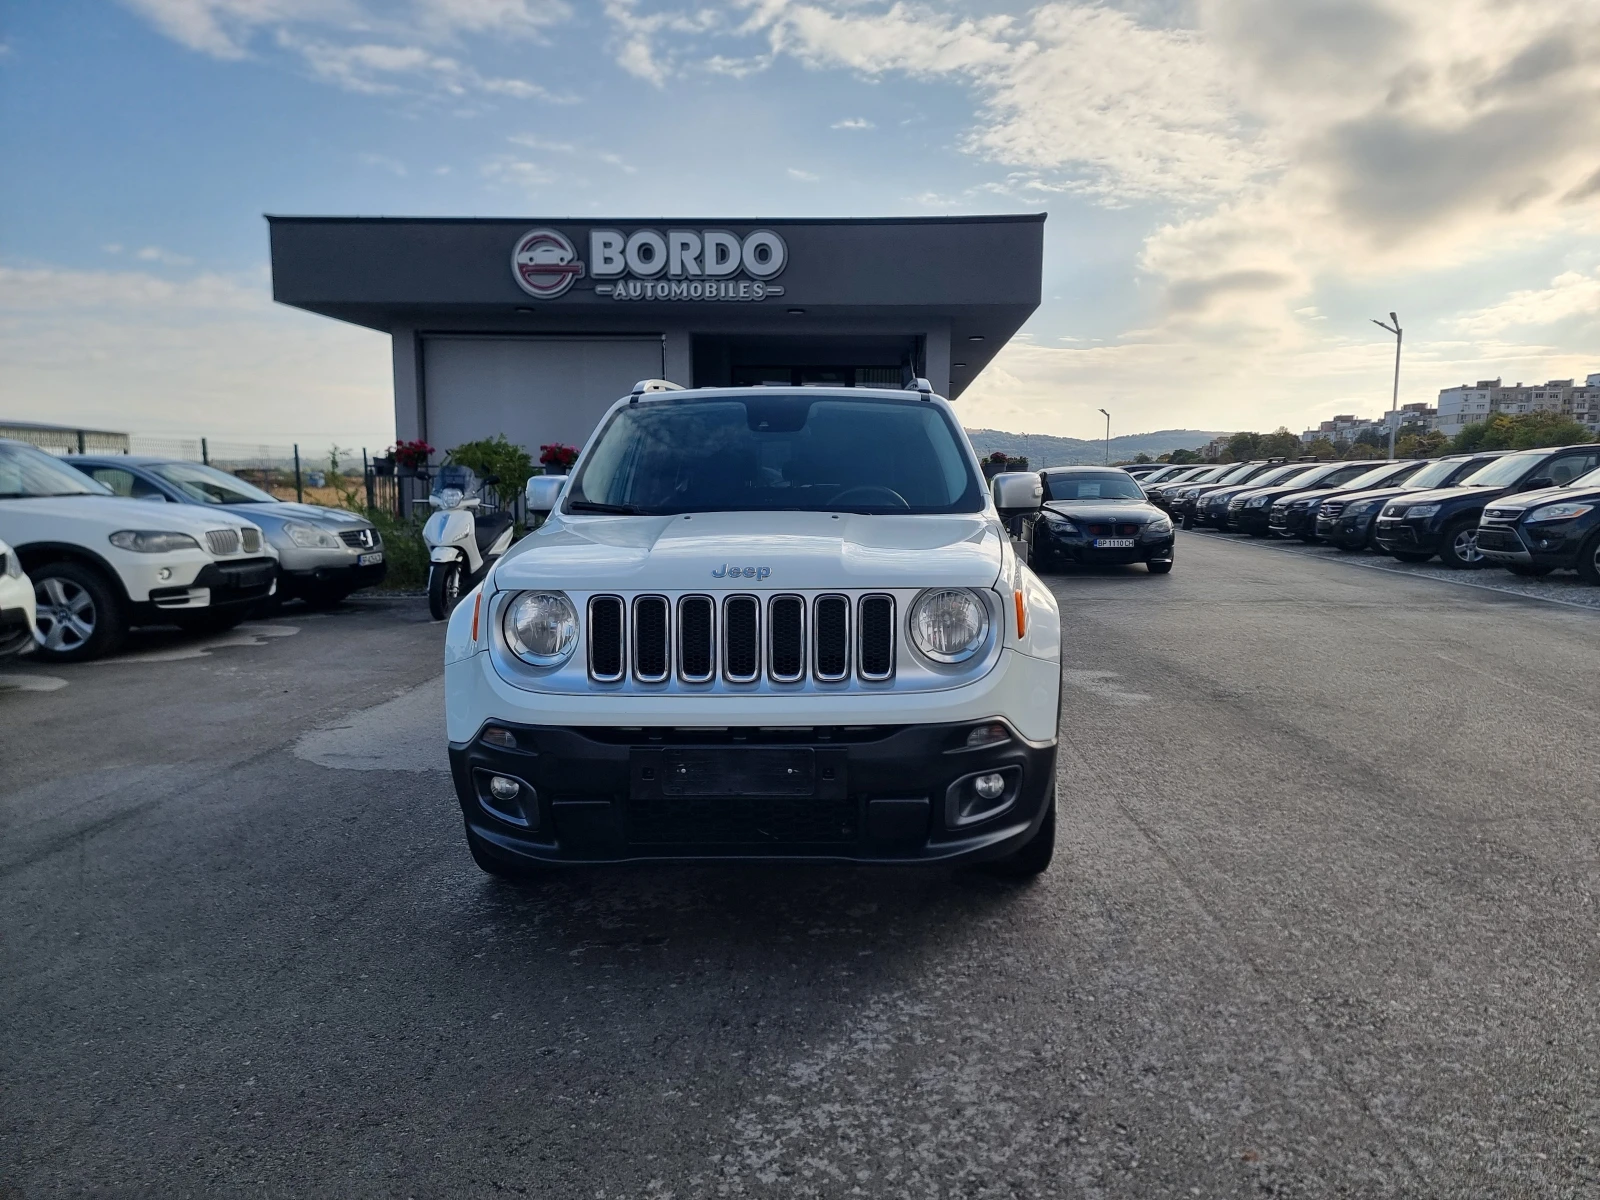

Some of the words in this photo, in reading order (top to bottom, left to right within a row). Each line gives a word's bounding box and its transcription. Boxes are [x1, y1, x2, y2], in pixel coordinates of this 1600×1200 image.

[591, 230, 784, 275] BORDO
[613, 281, 765, 298] AUTOMOBILES
[711, 563, 772, 582] Jeep
